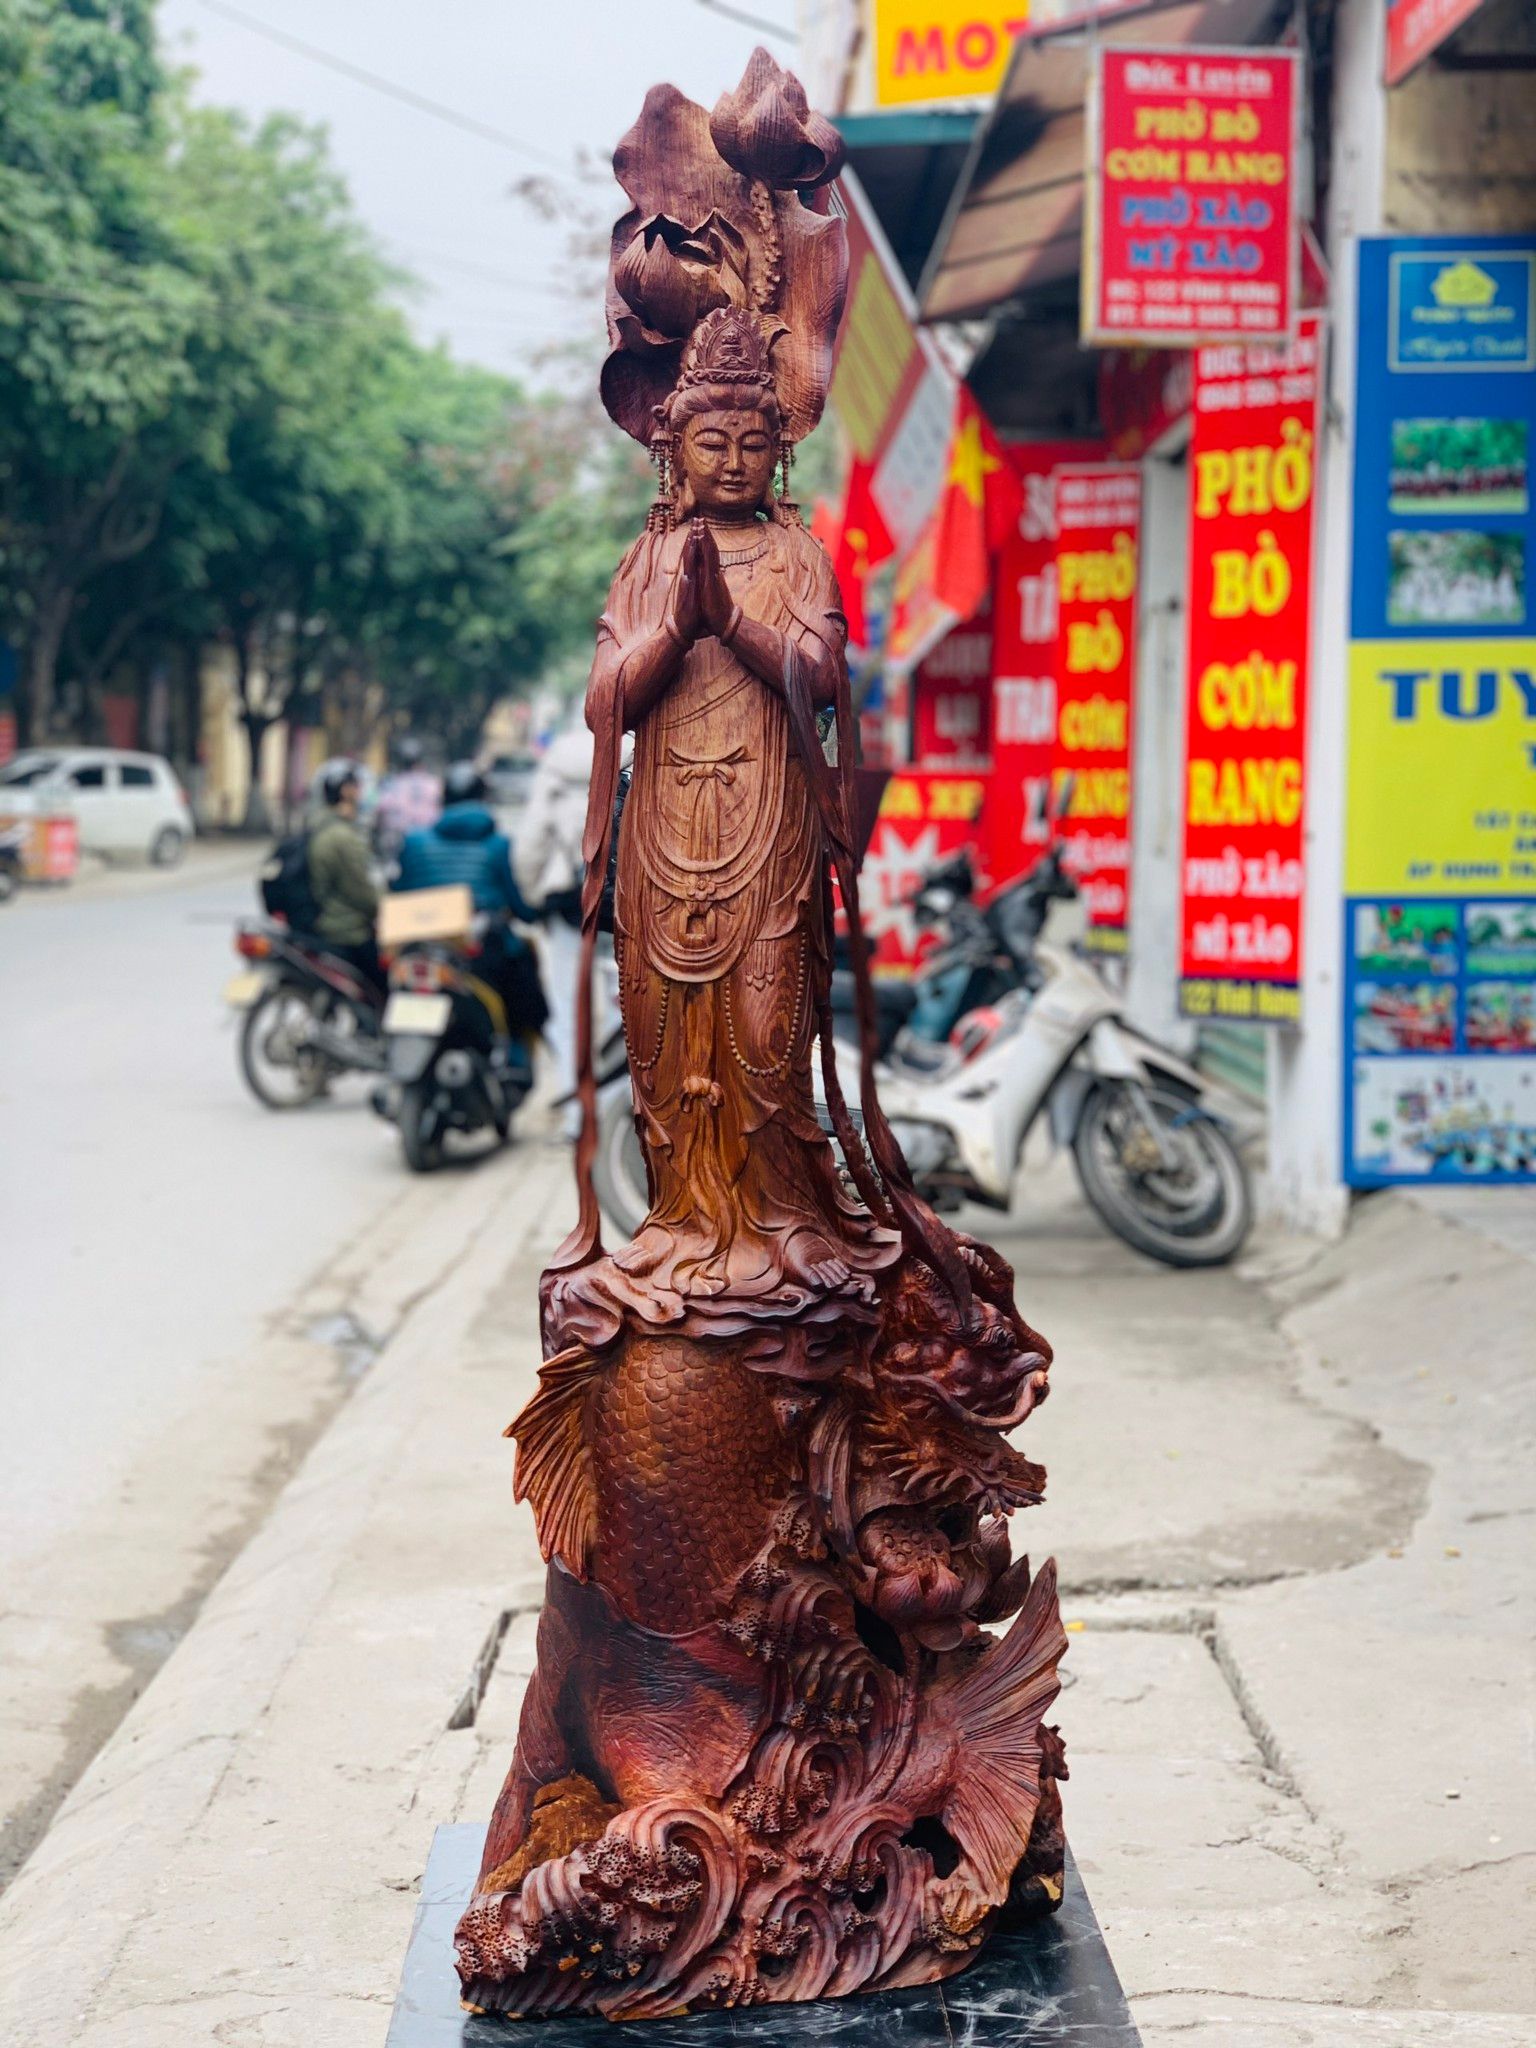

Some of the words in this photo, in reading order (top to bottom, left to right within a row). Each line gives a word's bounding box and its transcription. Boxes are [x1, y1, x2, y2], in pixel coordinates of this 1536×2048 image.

[1134, 98, 1207, 141] PHỞ
[1210, 103, 1260, 143] BÒ
[1107, 148, 1180, 182] CƠM
[1185, 151, 1285, 186] RANG
[1120, 187, 1191, 228] PHỞ
[1197, 191, 1273, 231] XÀO
[1187, 236, 1263, 273] XÀO
[1195, 416, 1313, 519] PHỞ
[1057, 531, 1136, 604] PHỞ
[1209, 529, 1292, 619] BÒ
[1066, 608, 1124, 674] BÒ
[1198, 650, 1298, 731] CƠM
[1187, 757, 1303, 827] RANG
[1242, 849, 1303, 898] XÀO
[1231, 914, 1292, 964] XÀO
